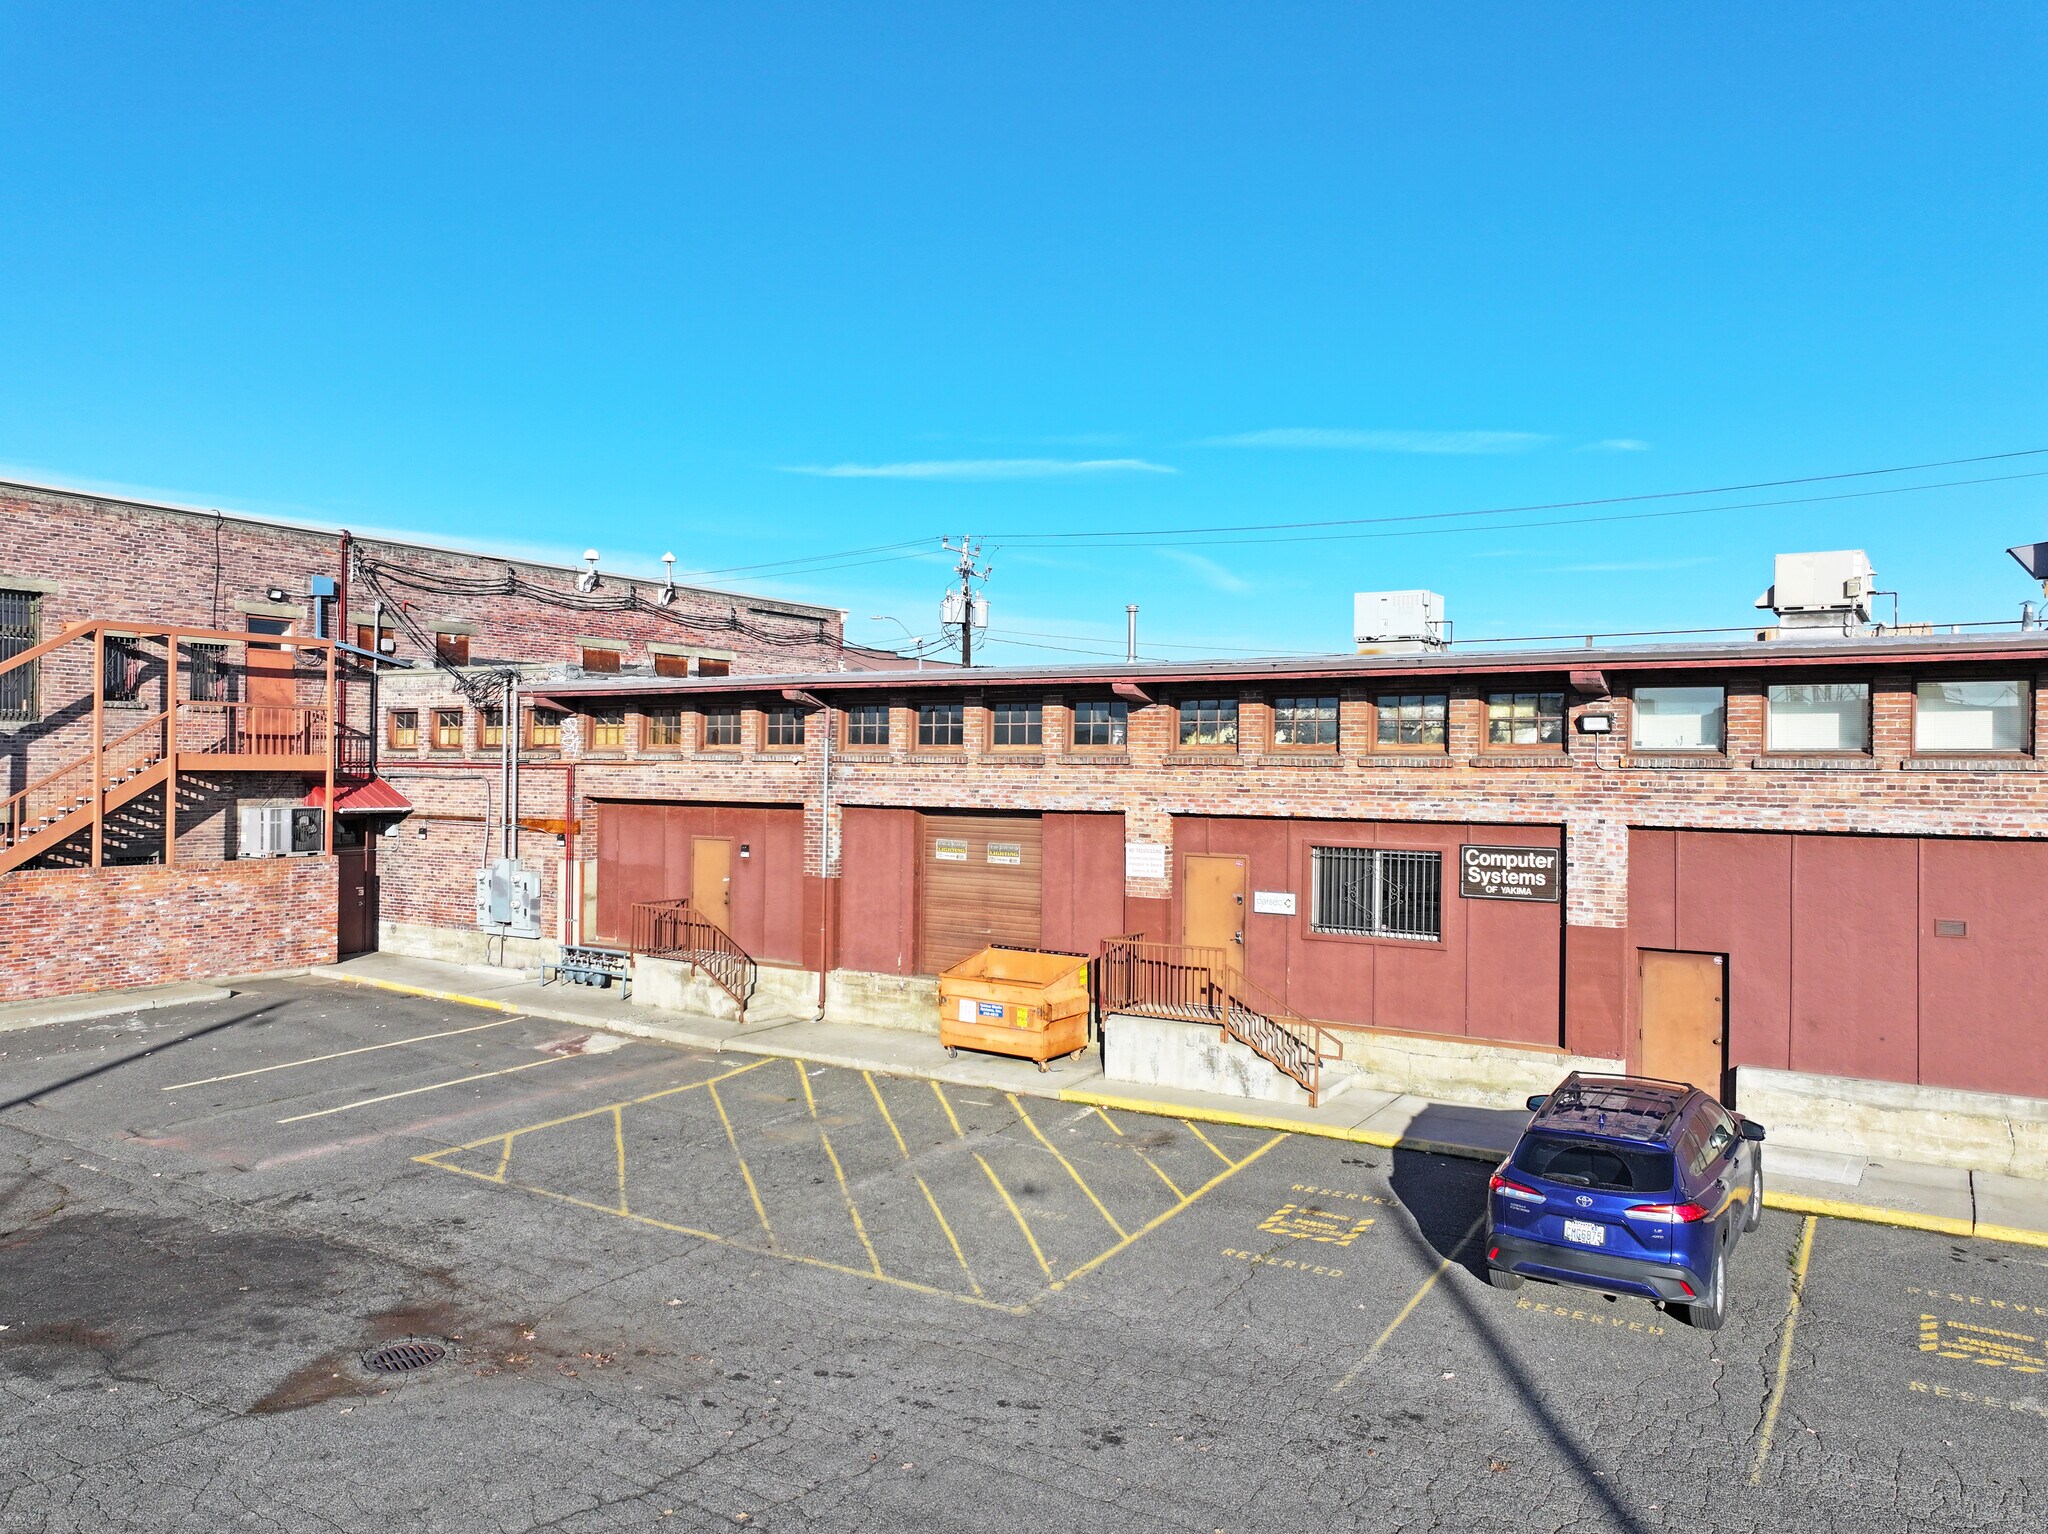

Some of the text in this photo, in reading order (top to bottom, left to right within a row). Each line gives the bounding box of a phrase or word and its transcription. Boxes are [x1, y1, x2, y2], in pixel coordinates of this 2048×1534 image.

[1465, 849, 1555, 870] Computer
[1467, 866, 1546, 886] Systems
[1485, 885, 1532, 895] OF YAKIMA
[1291, 1183, 1399, 1207] RESERVED
[1221, 1248, 1344, 1278] RESERVED
[1516, 1298, 1665, 1336] RESERVED
